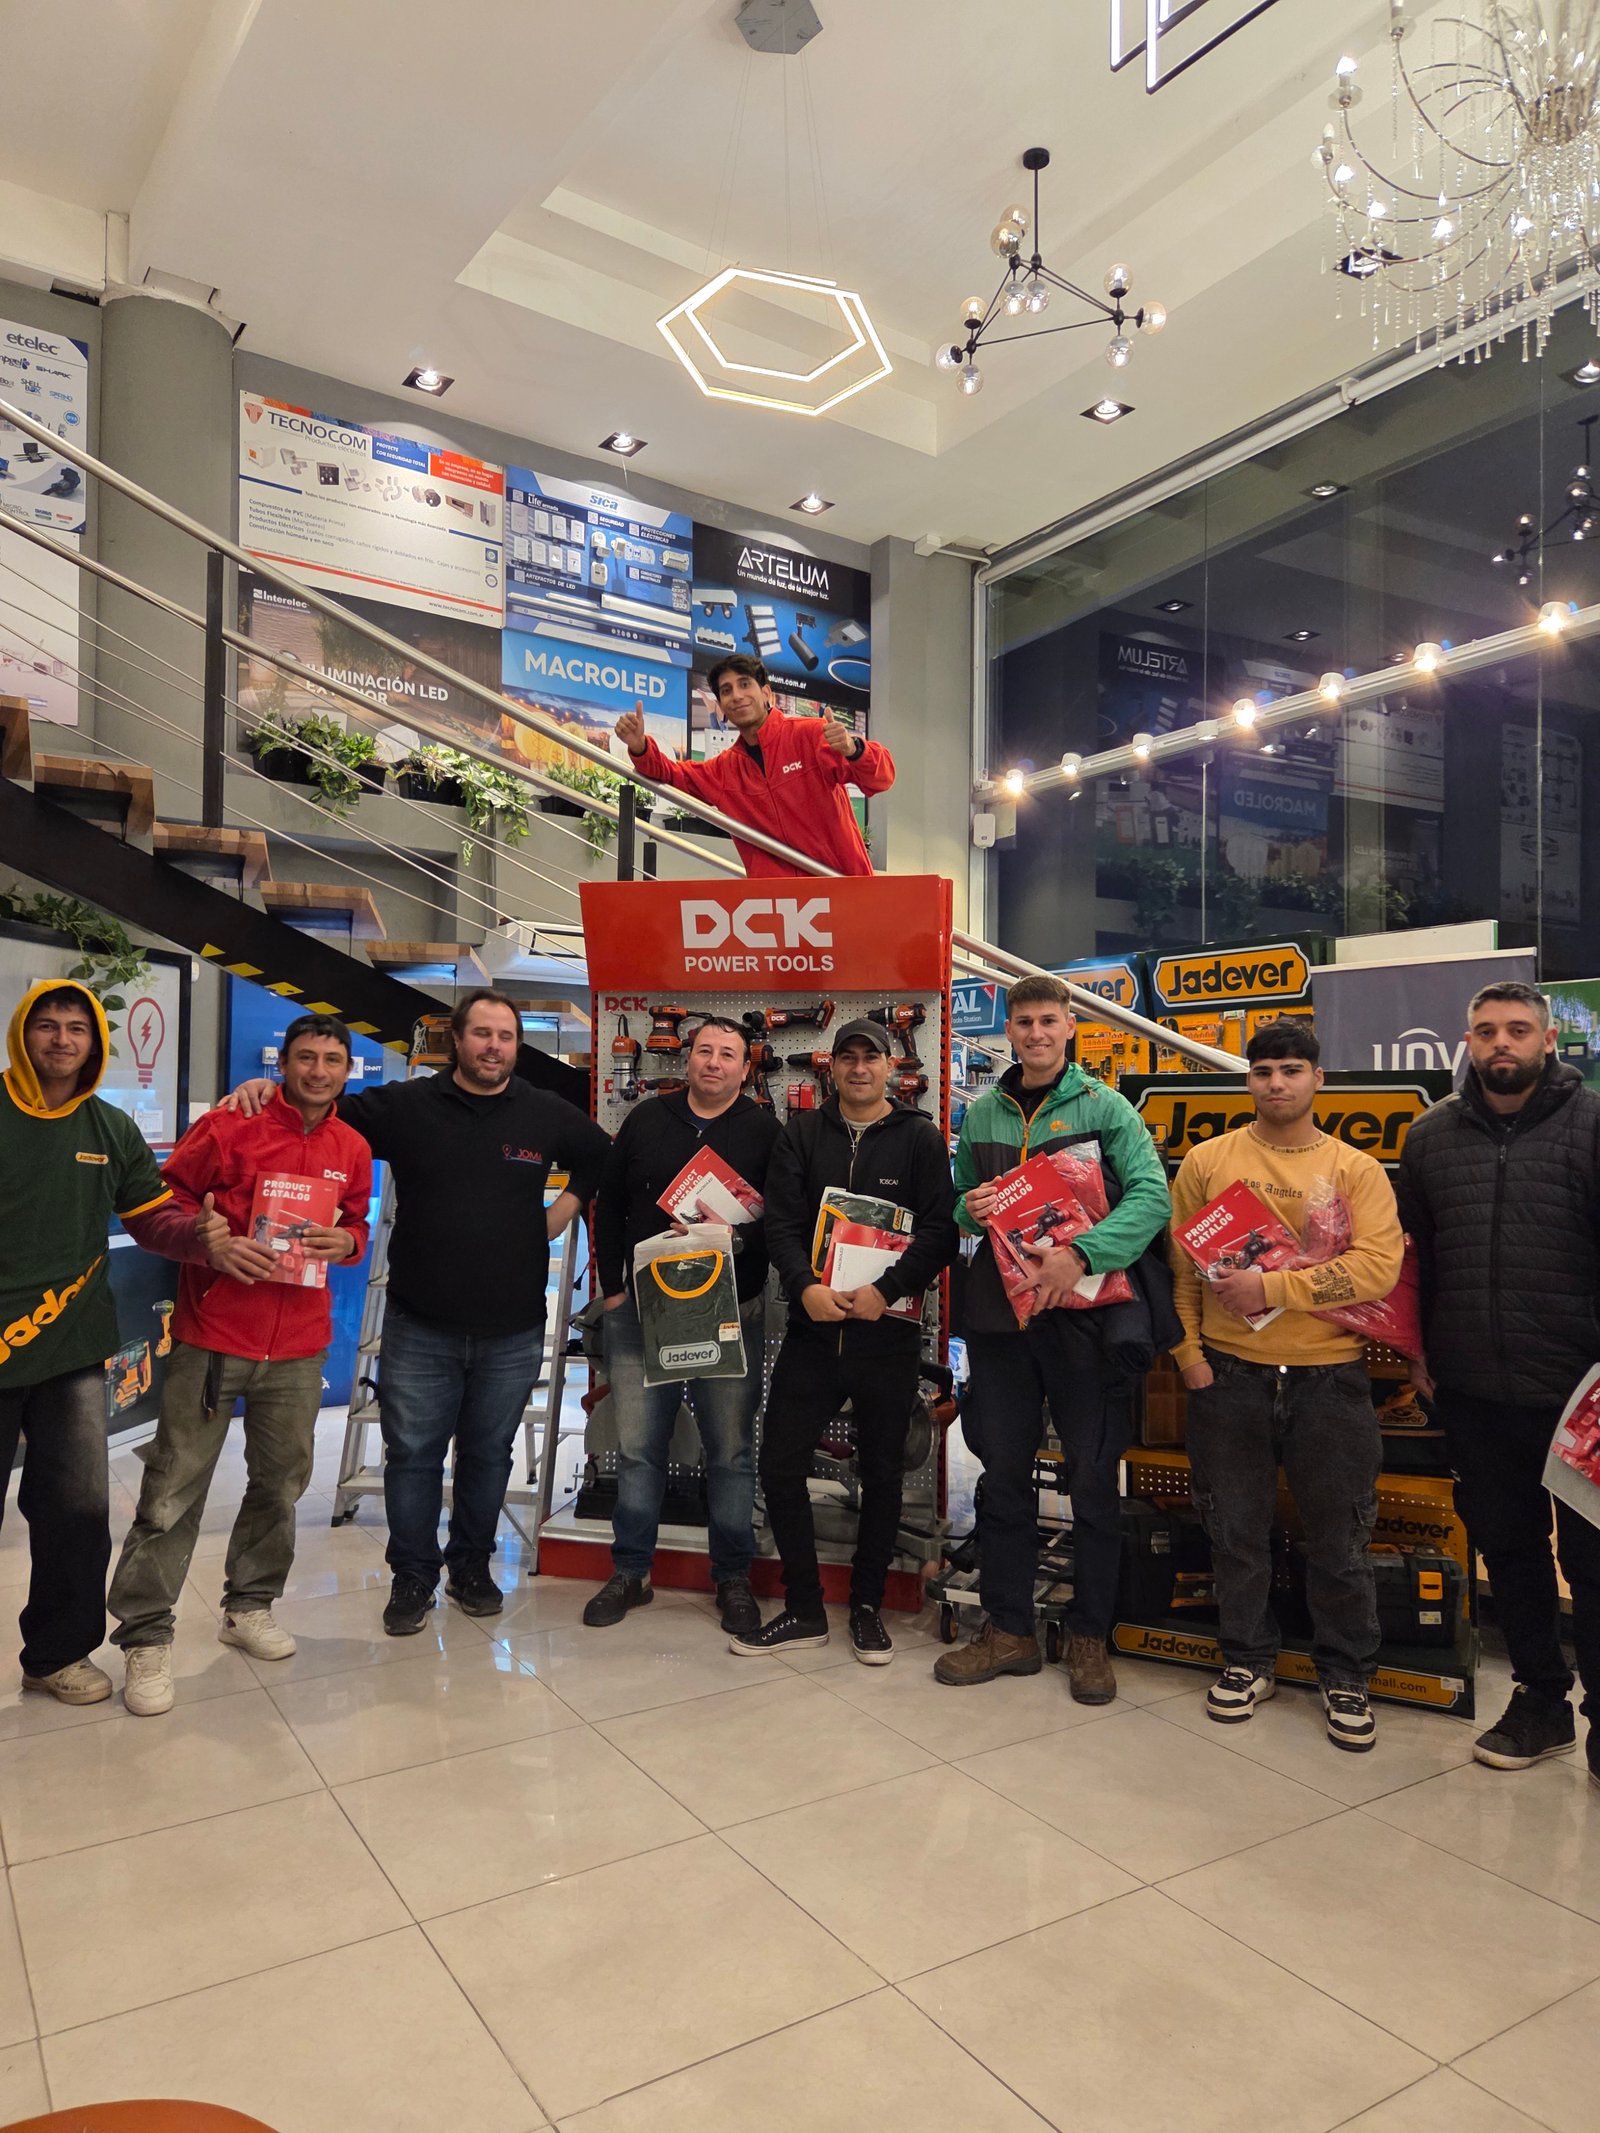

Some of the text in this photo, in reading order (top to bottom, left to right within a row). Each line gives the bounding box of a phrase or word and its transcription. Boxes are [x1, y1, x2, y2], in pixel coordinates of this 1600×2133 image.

[6, 333, 59, 355] etelec
[268, 411, 367, 450] TECNOCOM
[305, 435, 337, 449] Productos
[387, 452, 412, 463] SEGURIDAD
[412, 459, 425, 468] TOTAL
[249, 498, 283, 512] Compuestos
[293, 509, 304, 517] PVC
[304, 511, 327, 523] (Materia
[590, 495, 619, 510] sica
[249, 506, 326, 530] Tubos Flexibles (Mangueras)
[249, 513, 277, 526] Productos
[278, 520, 304, 533] Eléctricos
[249, 521, 285, 535] Construcción
[286, 530, 309, 541] húmeda
[641, 525, 676, 540] PROTECCIONES
[738, 547, 829, 591] ARTELUM
[525, 572, 556, 585] ARTEFACTOS
[566, 582, 576, 590] LED
[737, 568, 830, 600] Un mundo de luz, de la mejor luz.
[263, 590, 307, 609] Interelec
[306, 664, 449, 701] UMINACIÓN LED
[525, 648, 666, 699] MACROLED
[768, 674, 807, 690] elum.com.ar
[782, 760, 802, 774] DCK
[680, 897, 833, 949] DCK
[684, 954, 834, 972] POWER TOOLS
[1167, 959, 1295, 997] Jadever
[605, 997, 648, 1012] DCK
[952, 1015, 982, 1024] ools Station
[603, 1079, 647, 1094] DK
[1167, 1101, 1415, 1150] Javer
[323, 1169, 347, 1182] DCK
[262, 1189, 311, 1202] CATALOG
[263, 1180, 312, 1192] PRODUCT
[667, 1168, 698, 1207] PRODUCT
[996, 1175, 1028, 1203] ODUCT
[1264, 1183, 1303, 1199] Angeles
[992, 1183, 1034, 1216] CATALOG
[1184, 1204, 1227, 1241] PRODUCT
[1192, 1212, 1234, 1249] CATALOG
[906, 1297, 914, 1310] DC
[666, 1348, 714, 1363] Jadever
[1375, 1515, 1454, 1540] adever
[1138, 1631, 1219, 1660] Jadever
